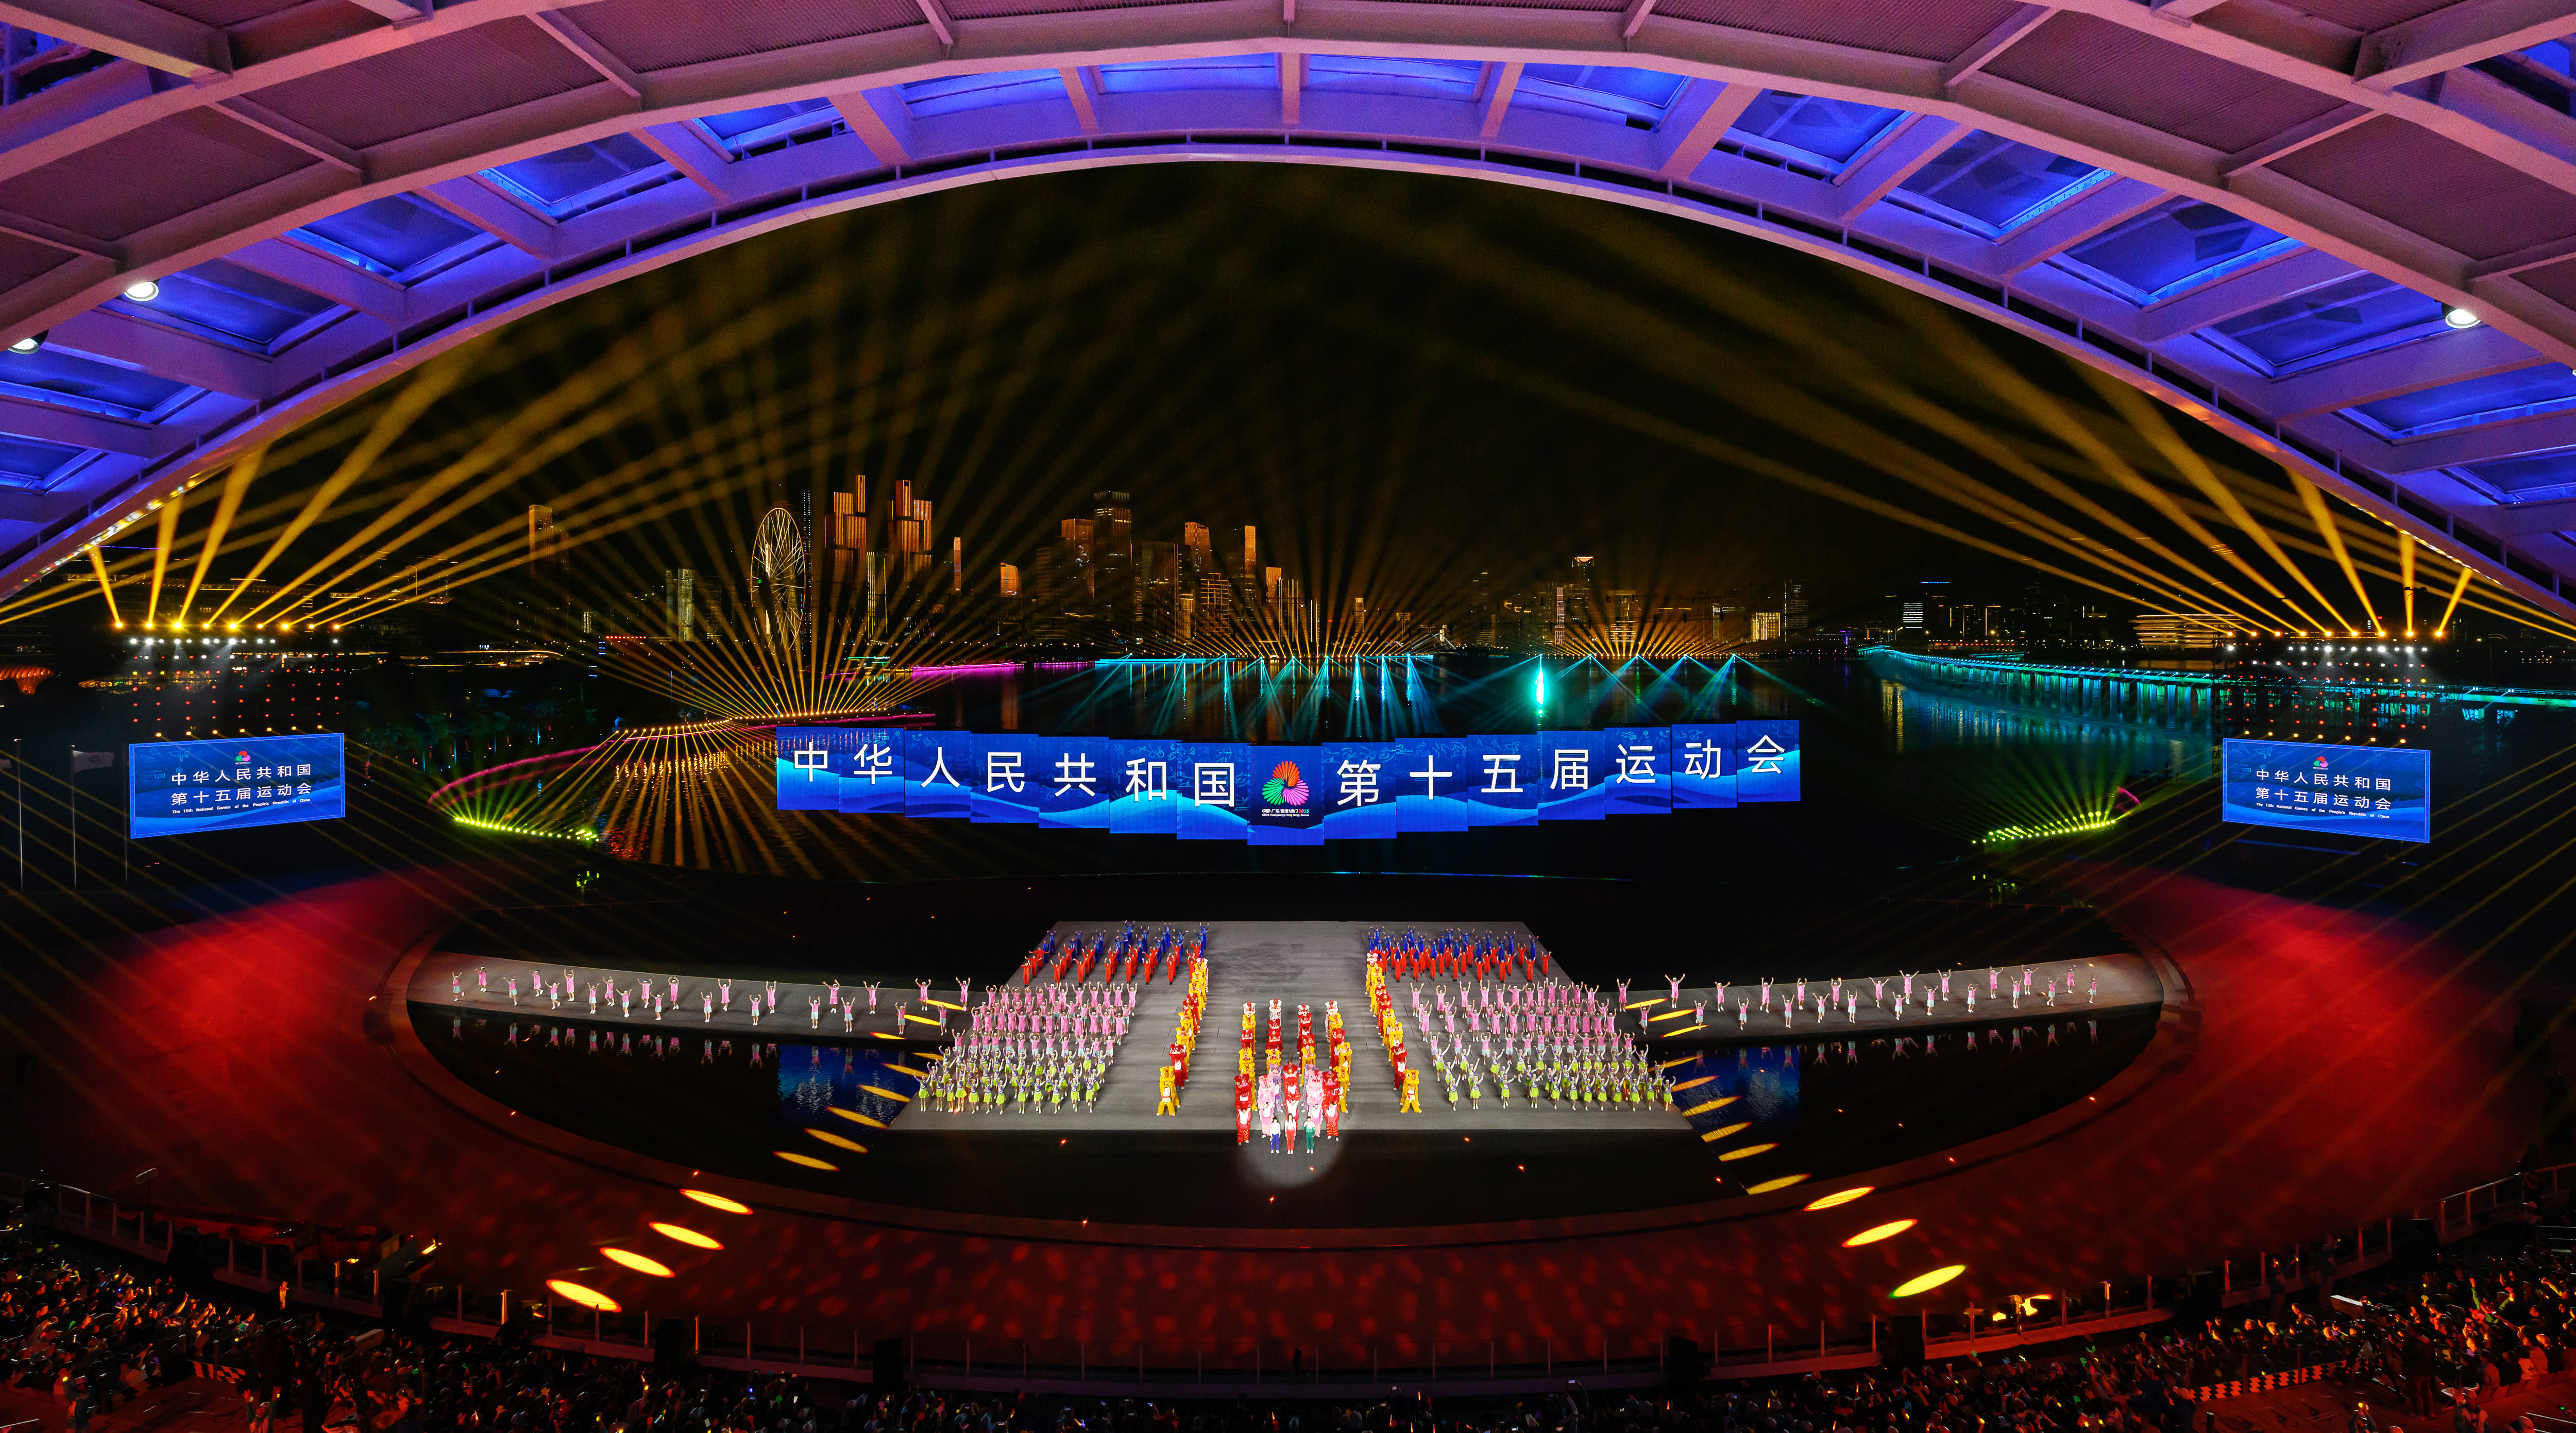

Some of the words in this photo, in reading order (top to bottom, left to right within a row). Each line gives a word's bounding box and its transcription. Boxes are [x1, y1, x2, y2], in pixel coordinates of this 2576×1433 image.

[171, 764, 311, 786] 中华人民共和国
[794, 741, 1234, 807] 中华人民共和国
[1336, 735, 1785, 806] 第十五届运动会
[2256, 768, 2391, 791] 中华人民共和国
[171, 782, 312, 806] 第十五届运动会
[2255, 787, 2392, 811] 第十五届运动会
